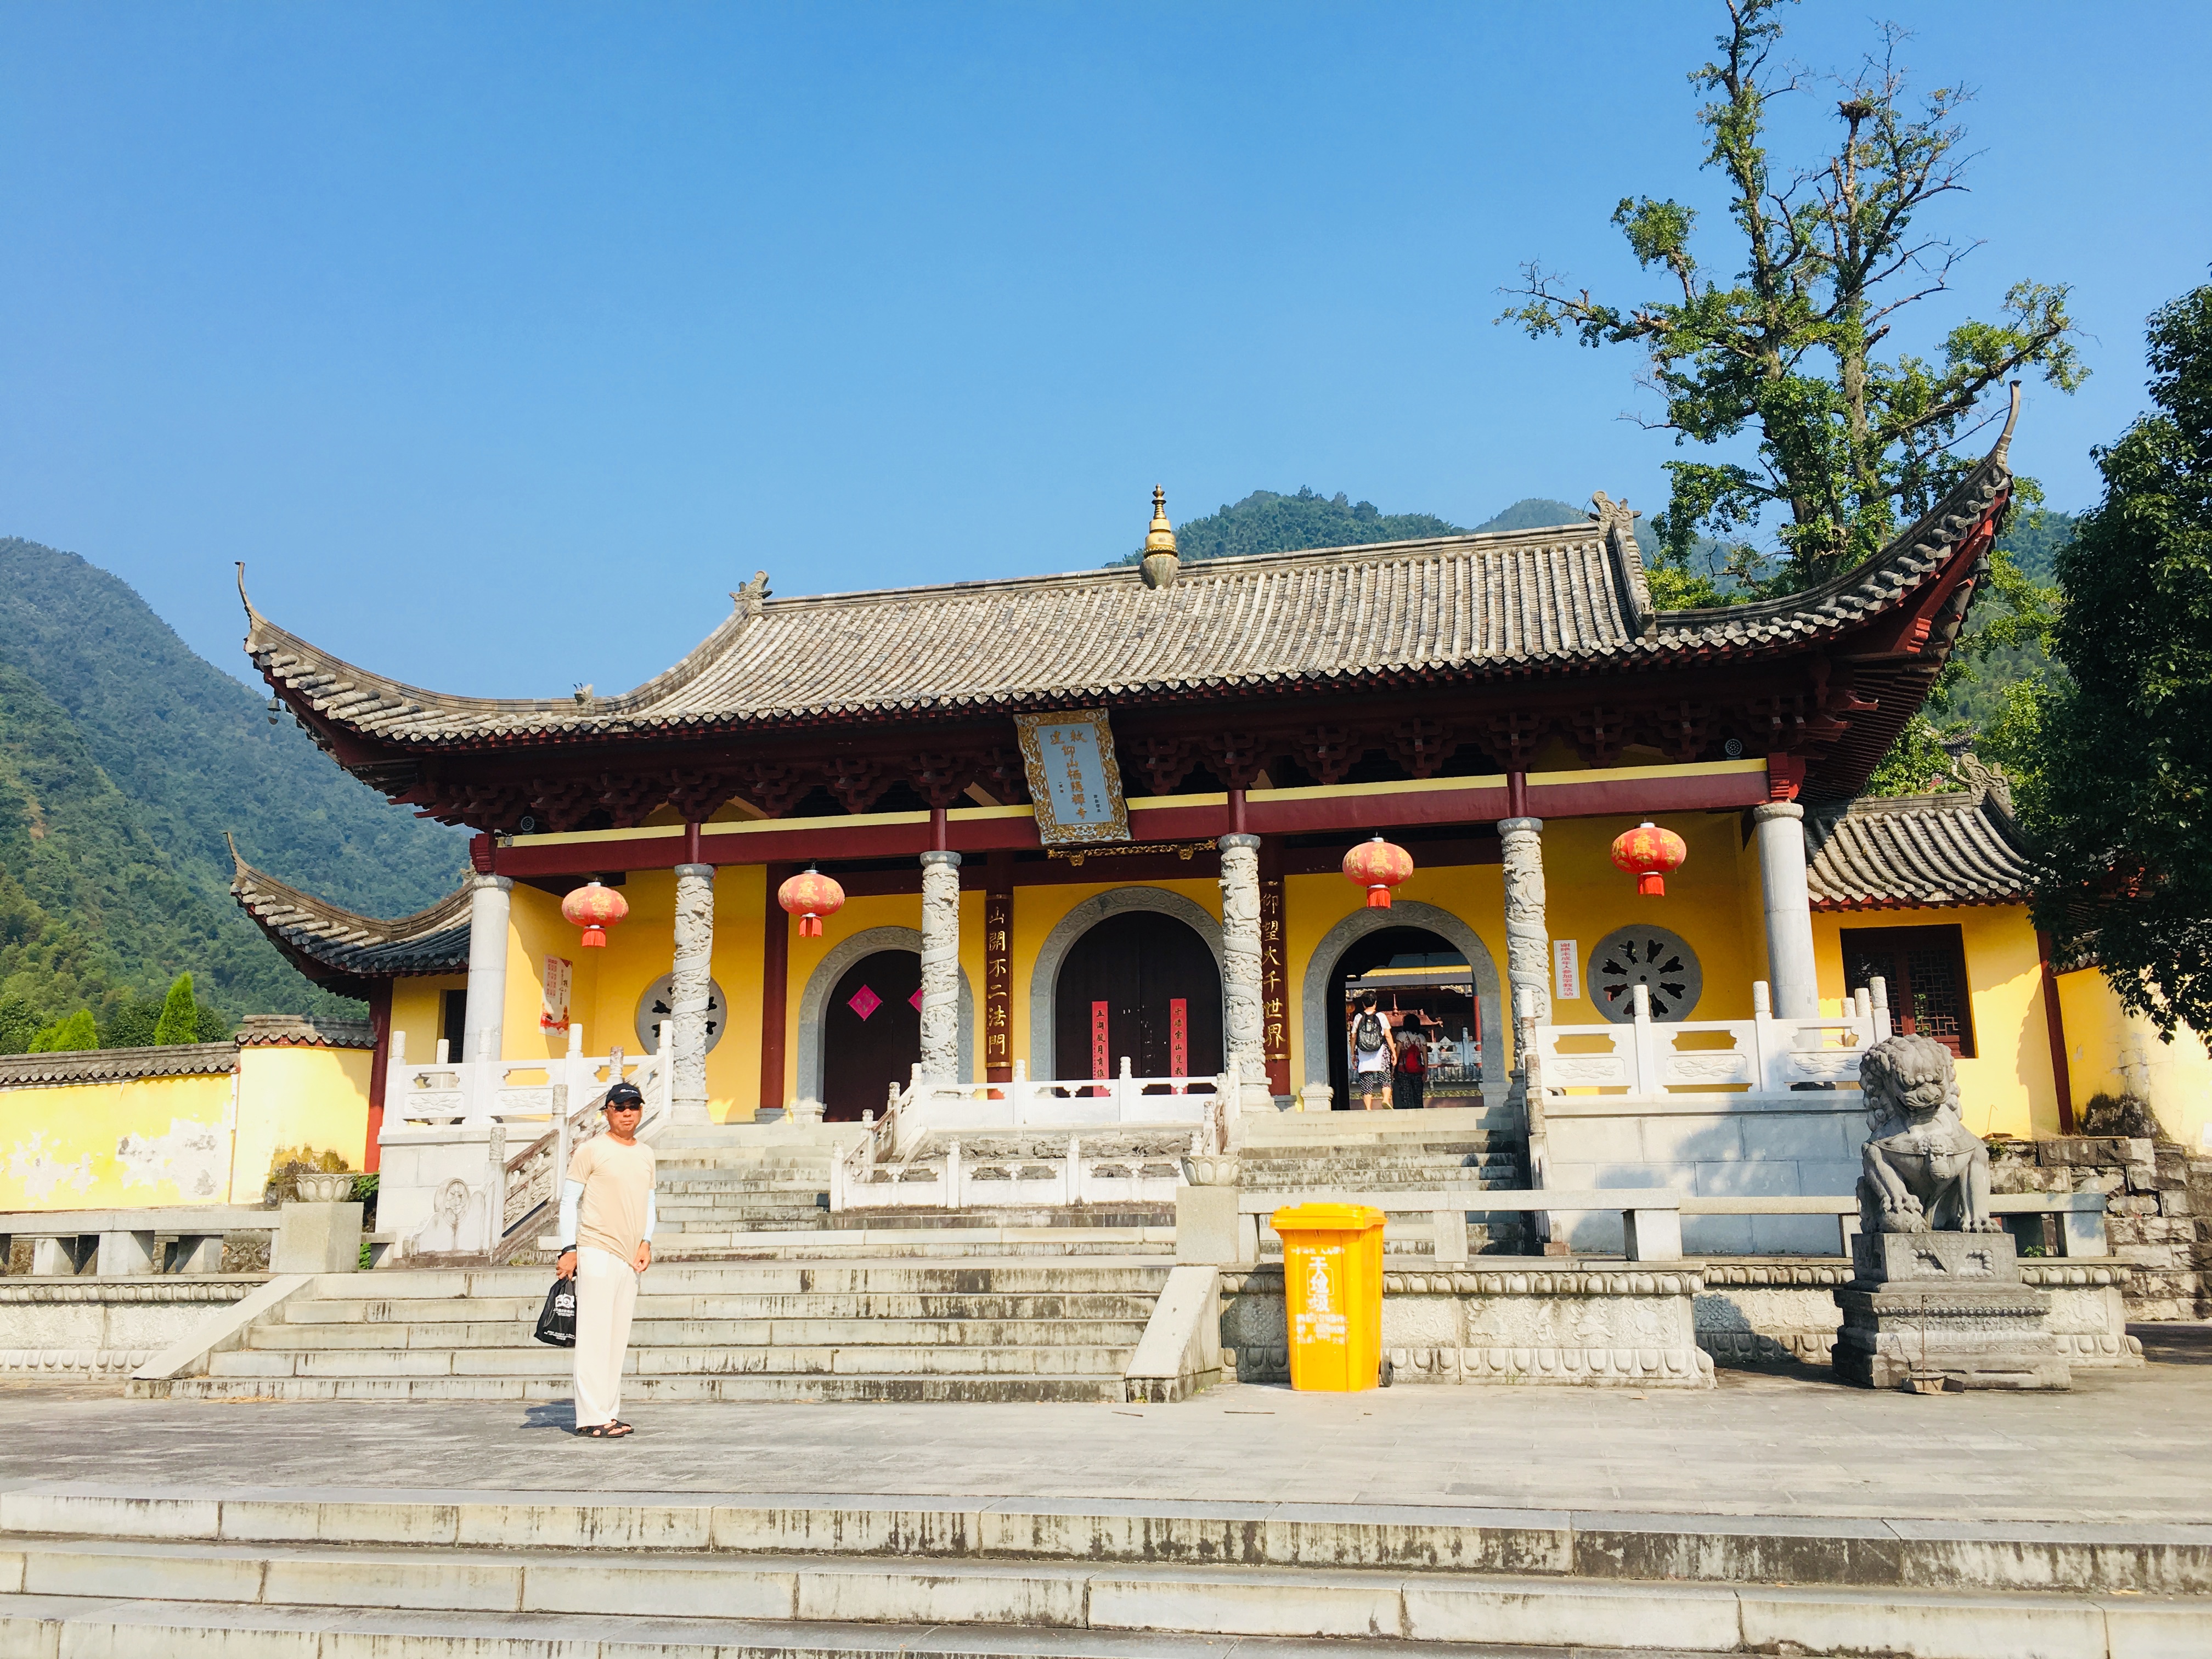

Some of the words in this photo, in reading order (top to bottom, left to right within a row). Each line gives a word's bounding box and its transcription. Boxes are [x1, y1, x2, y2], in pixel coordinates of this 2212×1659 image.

[988, 906, 1007, 1056] 山開不二法門
[1261, 892, 1286, 1049] 仰望大千世界
